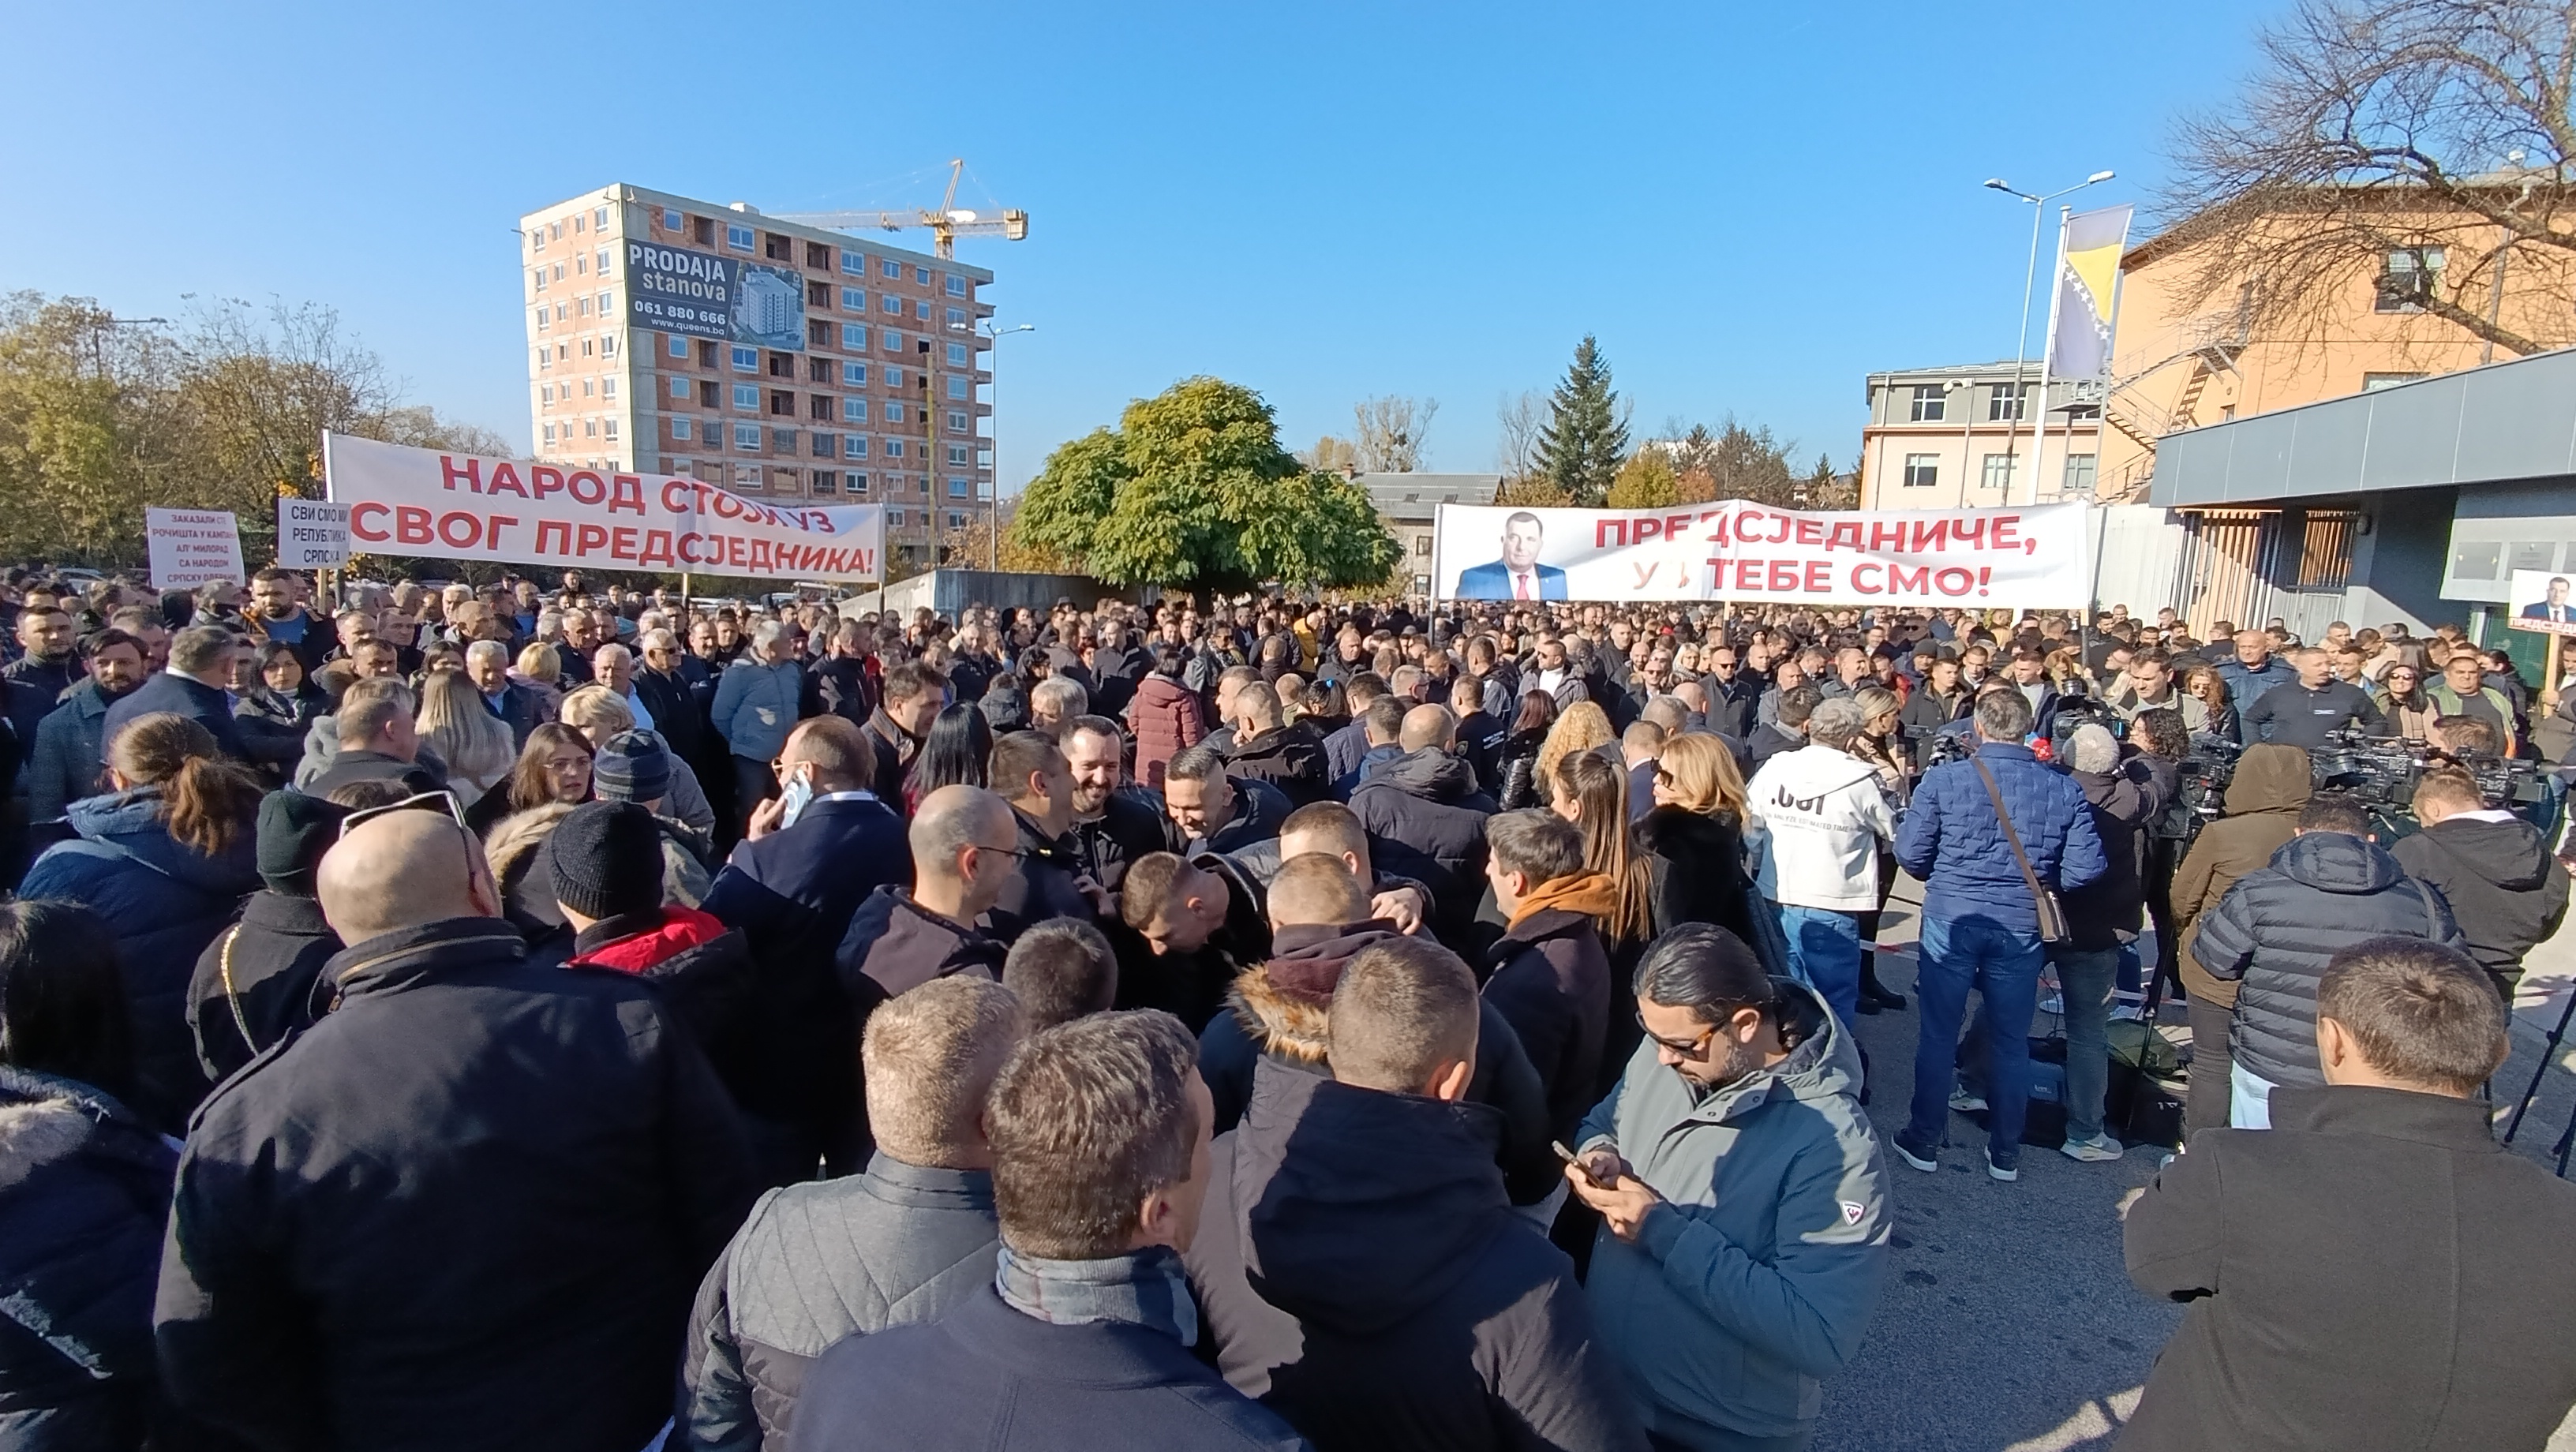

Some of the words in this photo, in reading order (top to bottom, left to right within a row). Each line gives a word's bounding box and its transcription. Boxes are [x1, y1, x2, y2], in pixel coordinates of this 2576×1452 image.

[629, 243, 726, 283] PRODAJA
[642, 271, 726, 302] stanova
[635, 300, 663, 316] 061
[668, 305, 695, 320] 880
[699, 310, 726, 325] 666
[651, 317, 724, 335] www.queens.ba
[440, 455, 646, 516] НАРОД
[784, 511, 836, 533] УЗ
[171, 515, 215, 524] ЗАКАЗАЛИ
[291, 506, 316, 520] СВИ
[318, 508, 336, 522] СМО
[152, 529, 198, 538] РОЧИШТА
[200, 530, 205, 538] У
[293, 527, 346, 543] РЕПУБЛИКА
[350, 501, 519, 551] СВОГ
[535, 519, 874, 574] ПРЕДСЈЕДНИКА!
[1596, 511, 2037, 555] ПРЕДСЈЕДНИЧЕ,
[193, 544, 229, 553] МИЛОРАД
[304, 549, 339, 563] СРПСКА
[193, 559, 229, 568] НАРОДОМ
[167, 574, 201, 582] СРПСКУ
[1706, 558, 1833, 592] ТЕБЕ
[1851, 563, 1991, 597] СМО!
[1833, 824, 1850, 833] TIME
